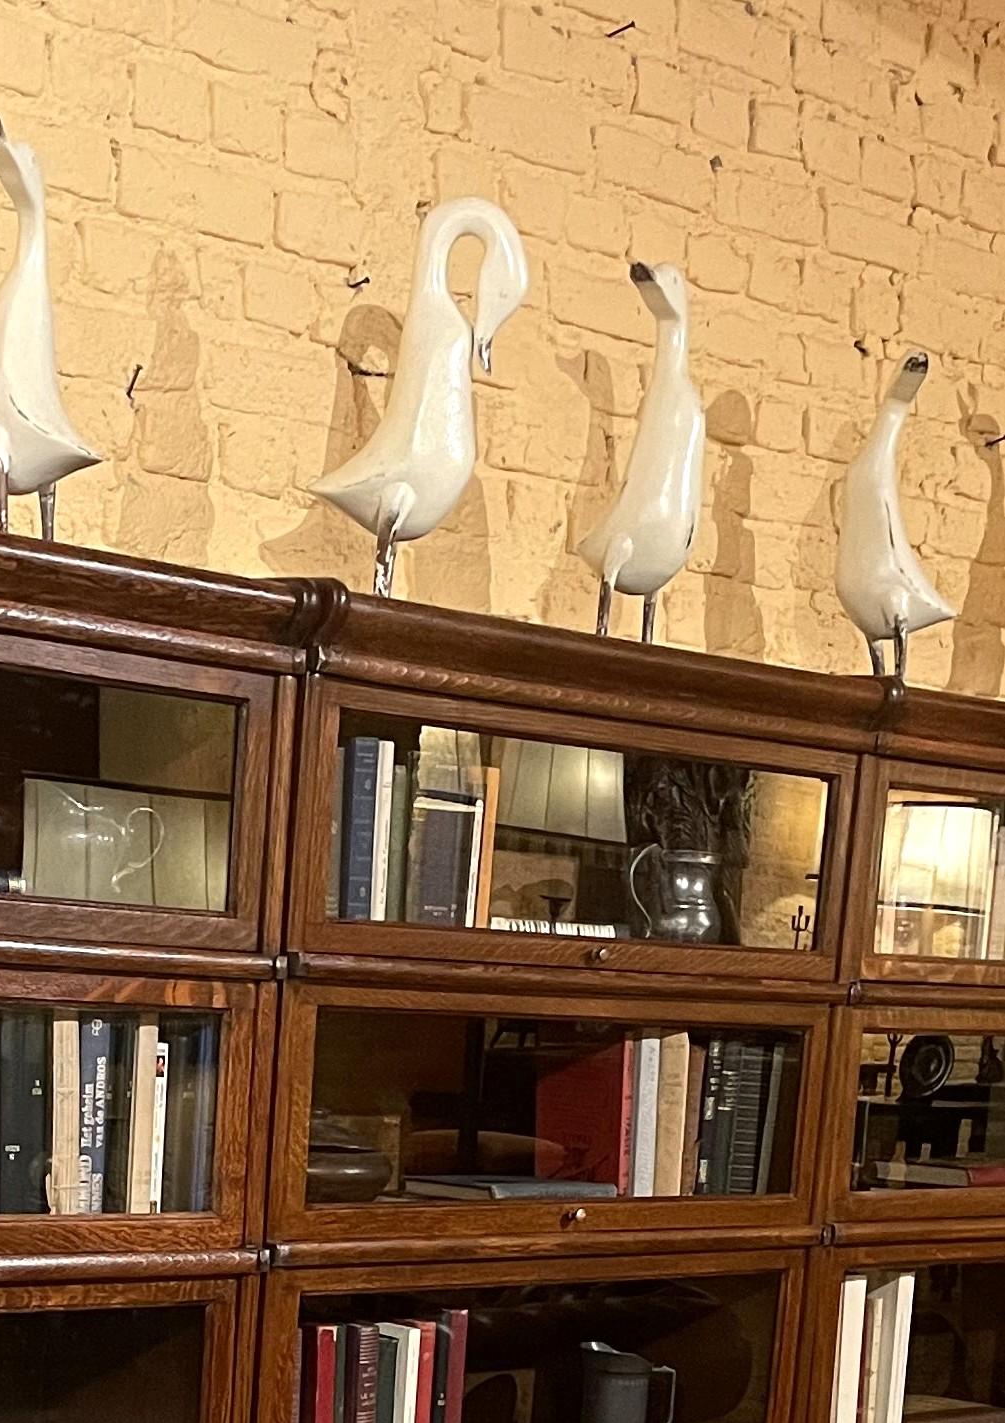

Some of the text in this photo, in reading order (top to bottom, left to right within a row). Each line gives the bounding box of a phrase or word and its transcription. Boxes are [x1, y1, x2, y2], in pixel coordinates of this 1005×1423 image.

[81, 1083, 94, 1148] Het geheim
[95, 1056, 107, 1148] van de ANDROS
